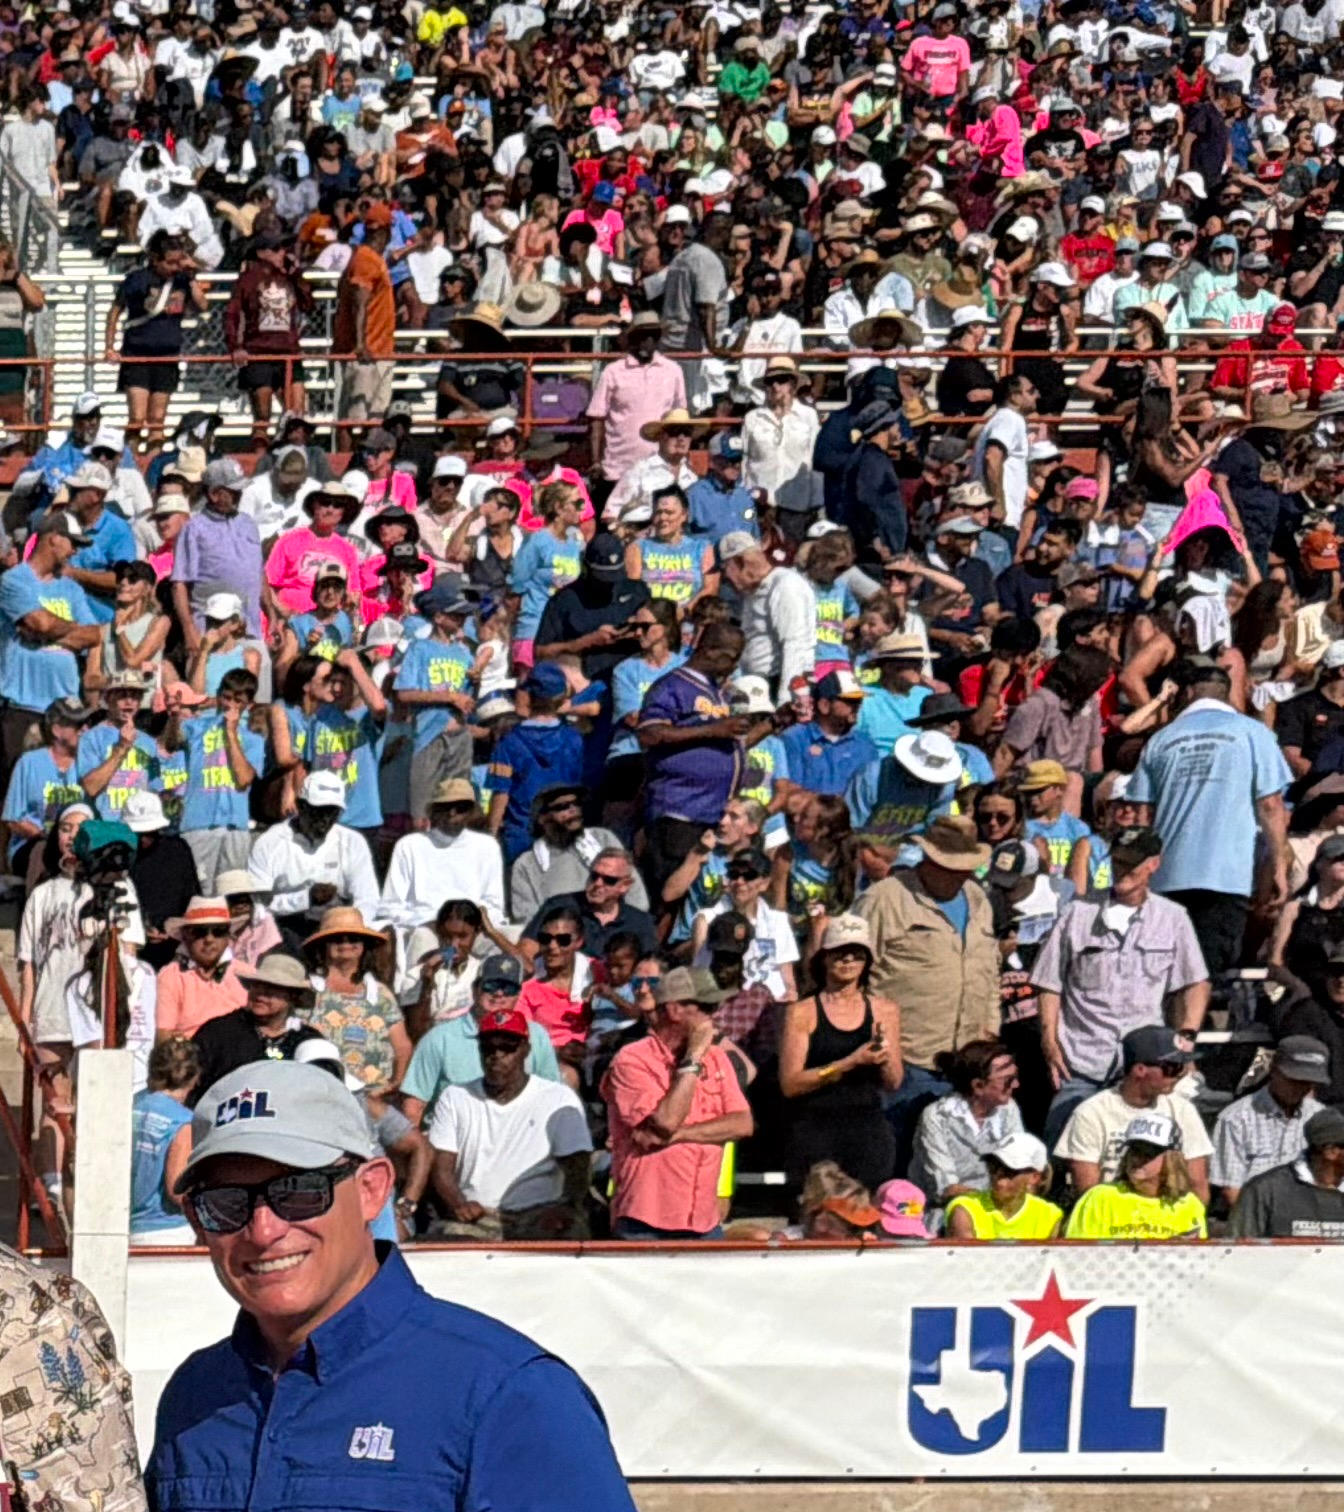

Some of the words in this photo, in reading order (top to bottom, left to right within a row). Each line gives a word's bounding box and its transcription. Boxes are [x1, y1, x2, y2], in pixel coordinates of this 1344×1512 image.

[215, 1090, 275, 1128] UIL
[909, 1304, 1167, 1455] UIL
[348, 1424, 395, 1460] UIL
